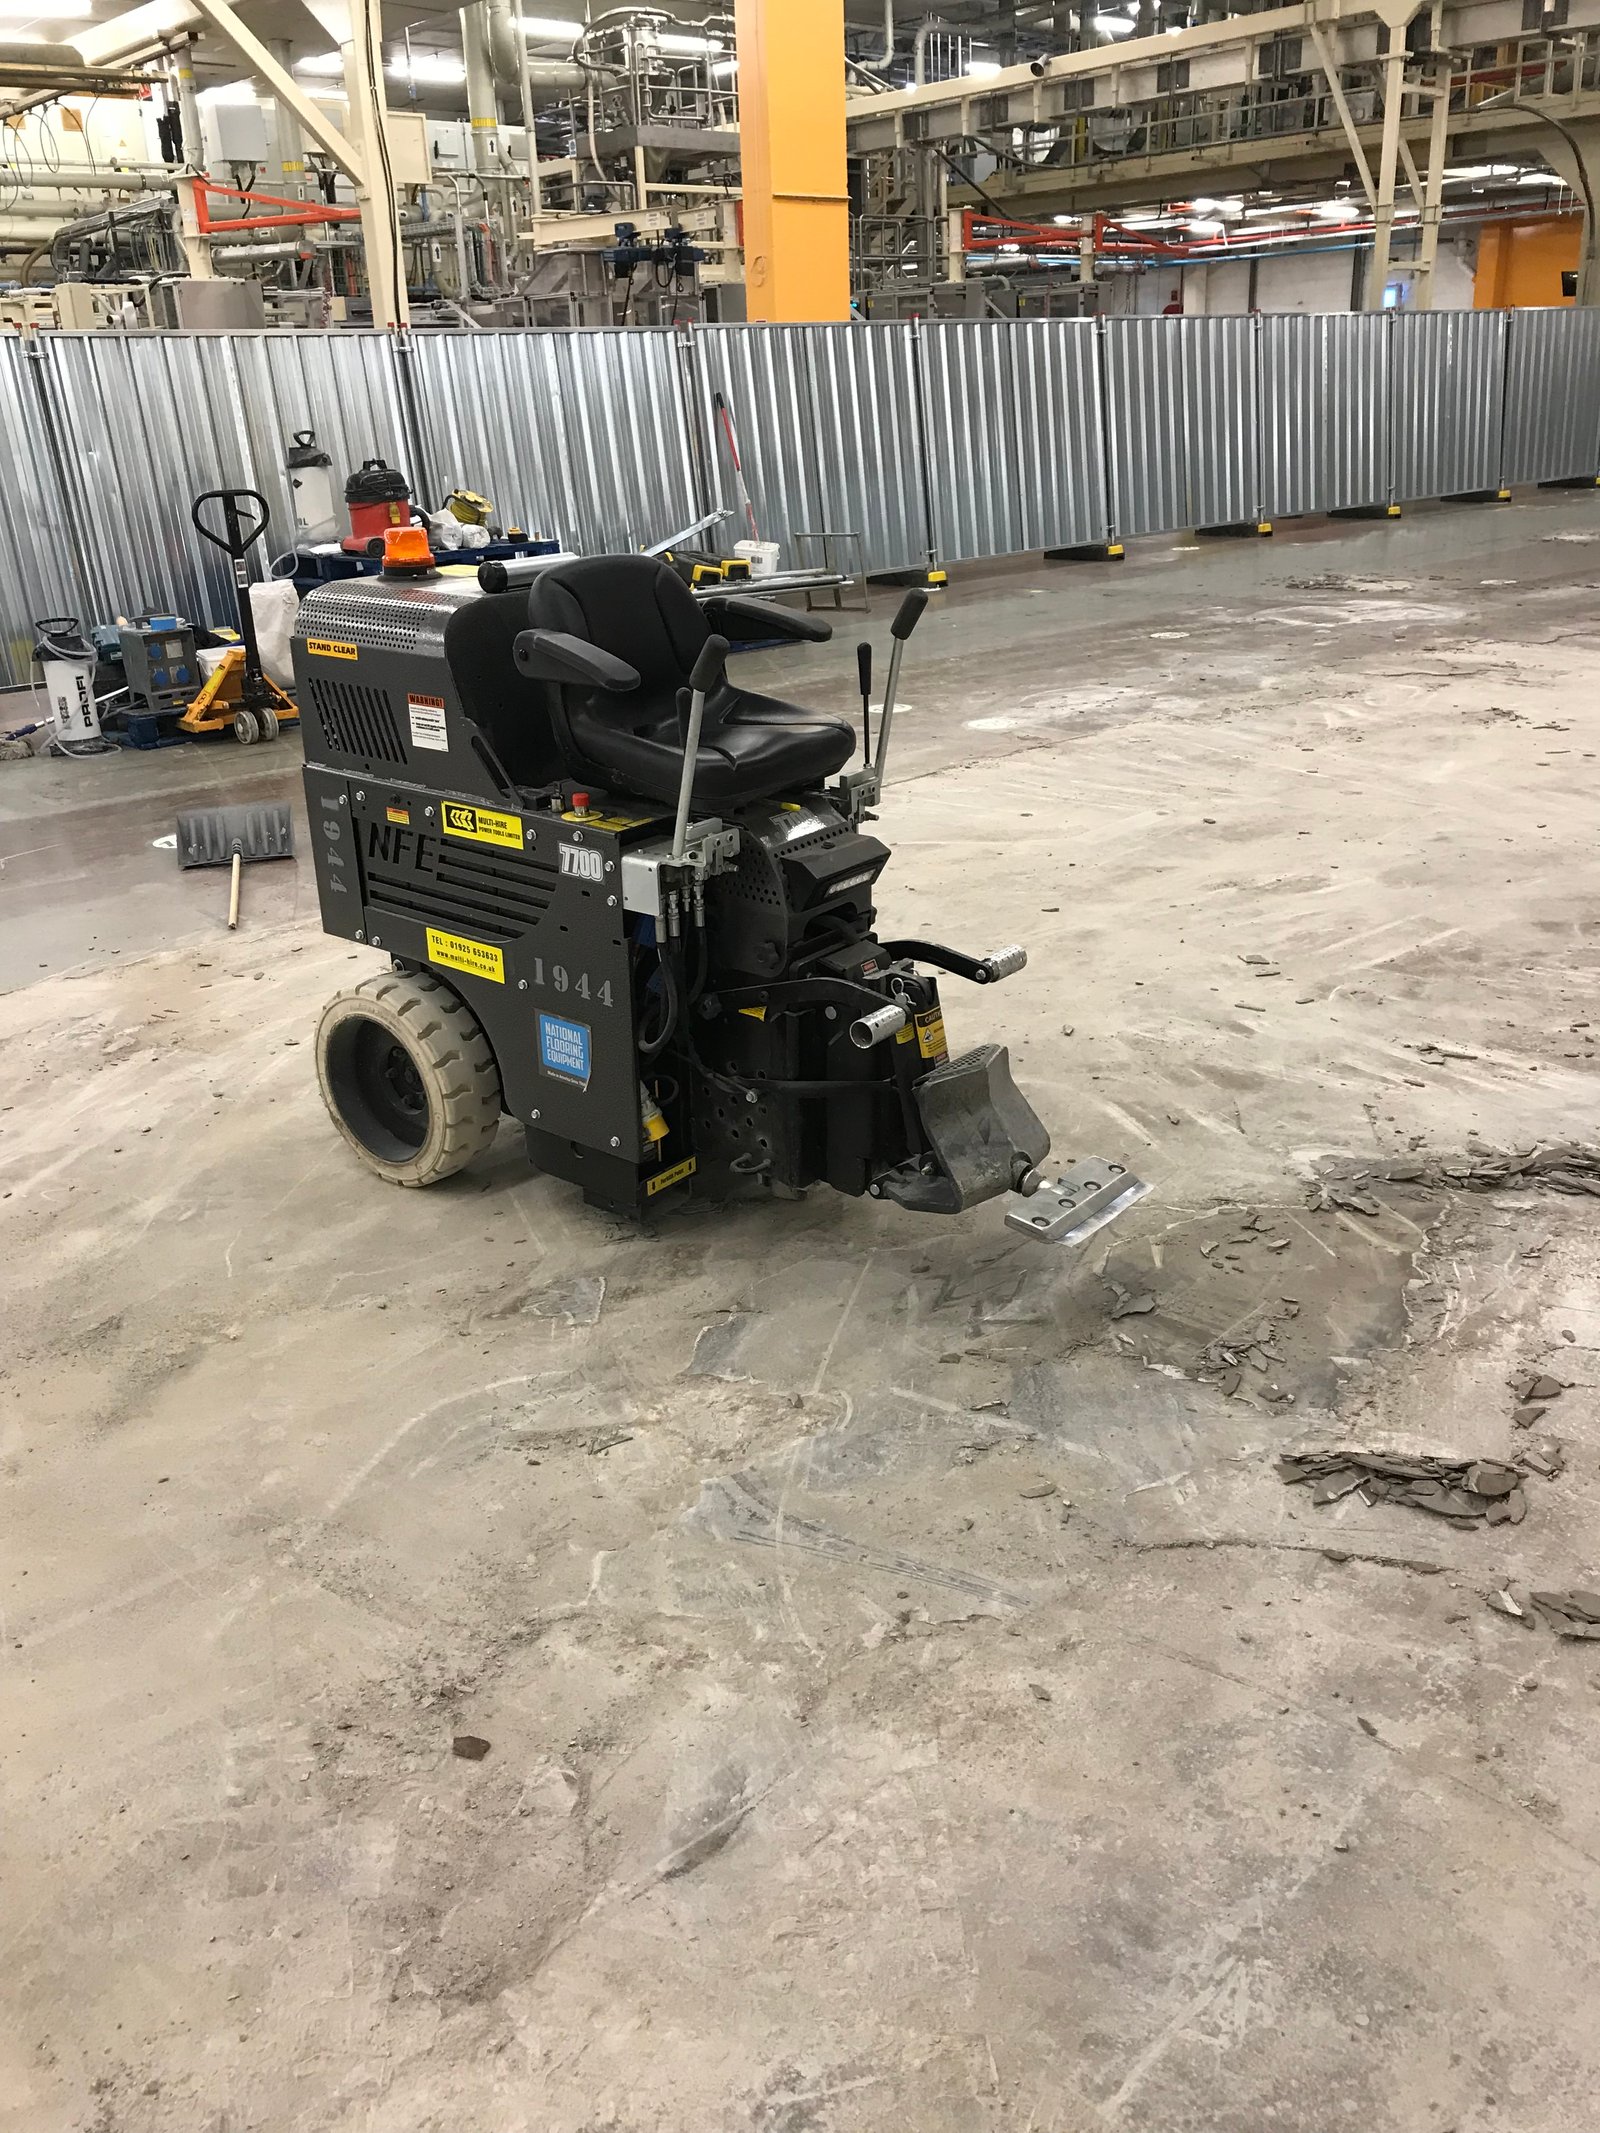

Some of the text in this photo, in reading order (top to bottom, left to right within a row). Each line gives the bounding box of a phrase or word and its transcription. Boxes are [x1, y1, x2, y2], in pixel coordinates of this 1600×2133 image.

[309, 642, 356, 655] STAND CLEAR
[75, 675, 93, 728] PROFI
[409, 695, 443, 707] WARNING!
[478, 816, 507, 829] MULTI-HIRE
[479, 826, 520, 841] POWER TOOLS LIMITED
[321, 796, 347, 893] 1944
[369, 823, 437, 872] NFE
[559, 843, 603, 881] 7700
[431, 935, 443, 946] TEL
[450, 941, 471, 954] 01925
[473, 947, 498, 962] 653633
[436, 950, 496, 973] www.multi-hire.co.uk
[535, 957, 614, 1008] 1944
[545, 1022, 583, 1046] NATIONAL
[546, 1036, 584, 1059] FLOORING
[547, 1049, 584, 1071] EQUIPMENT
